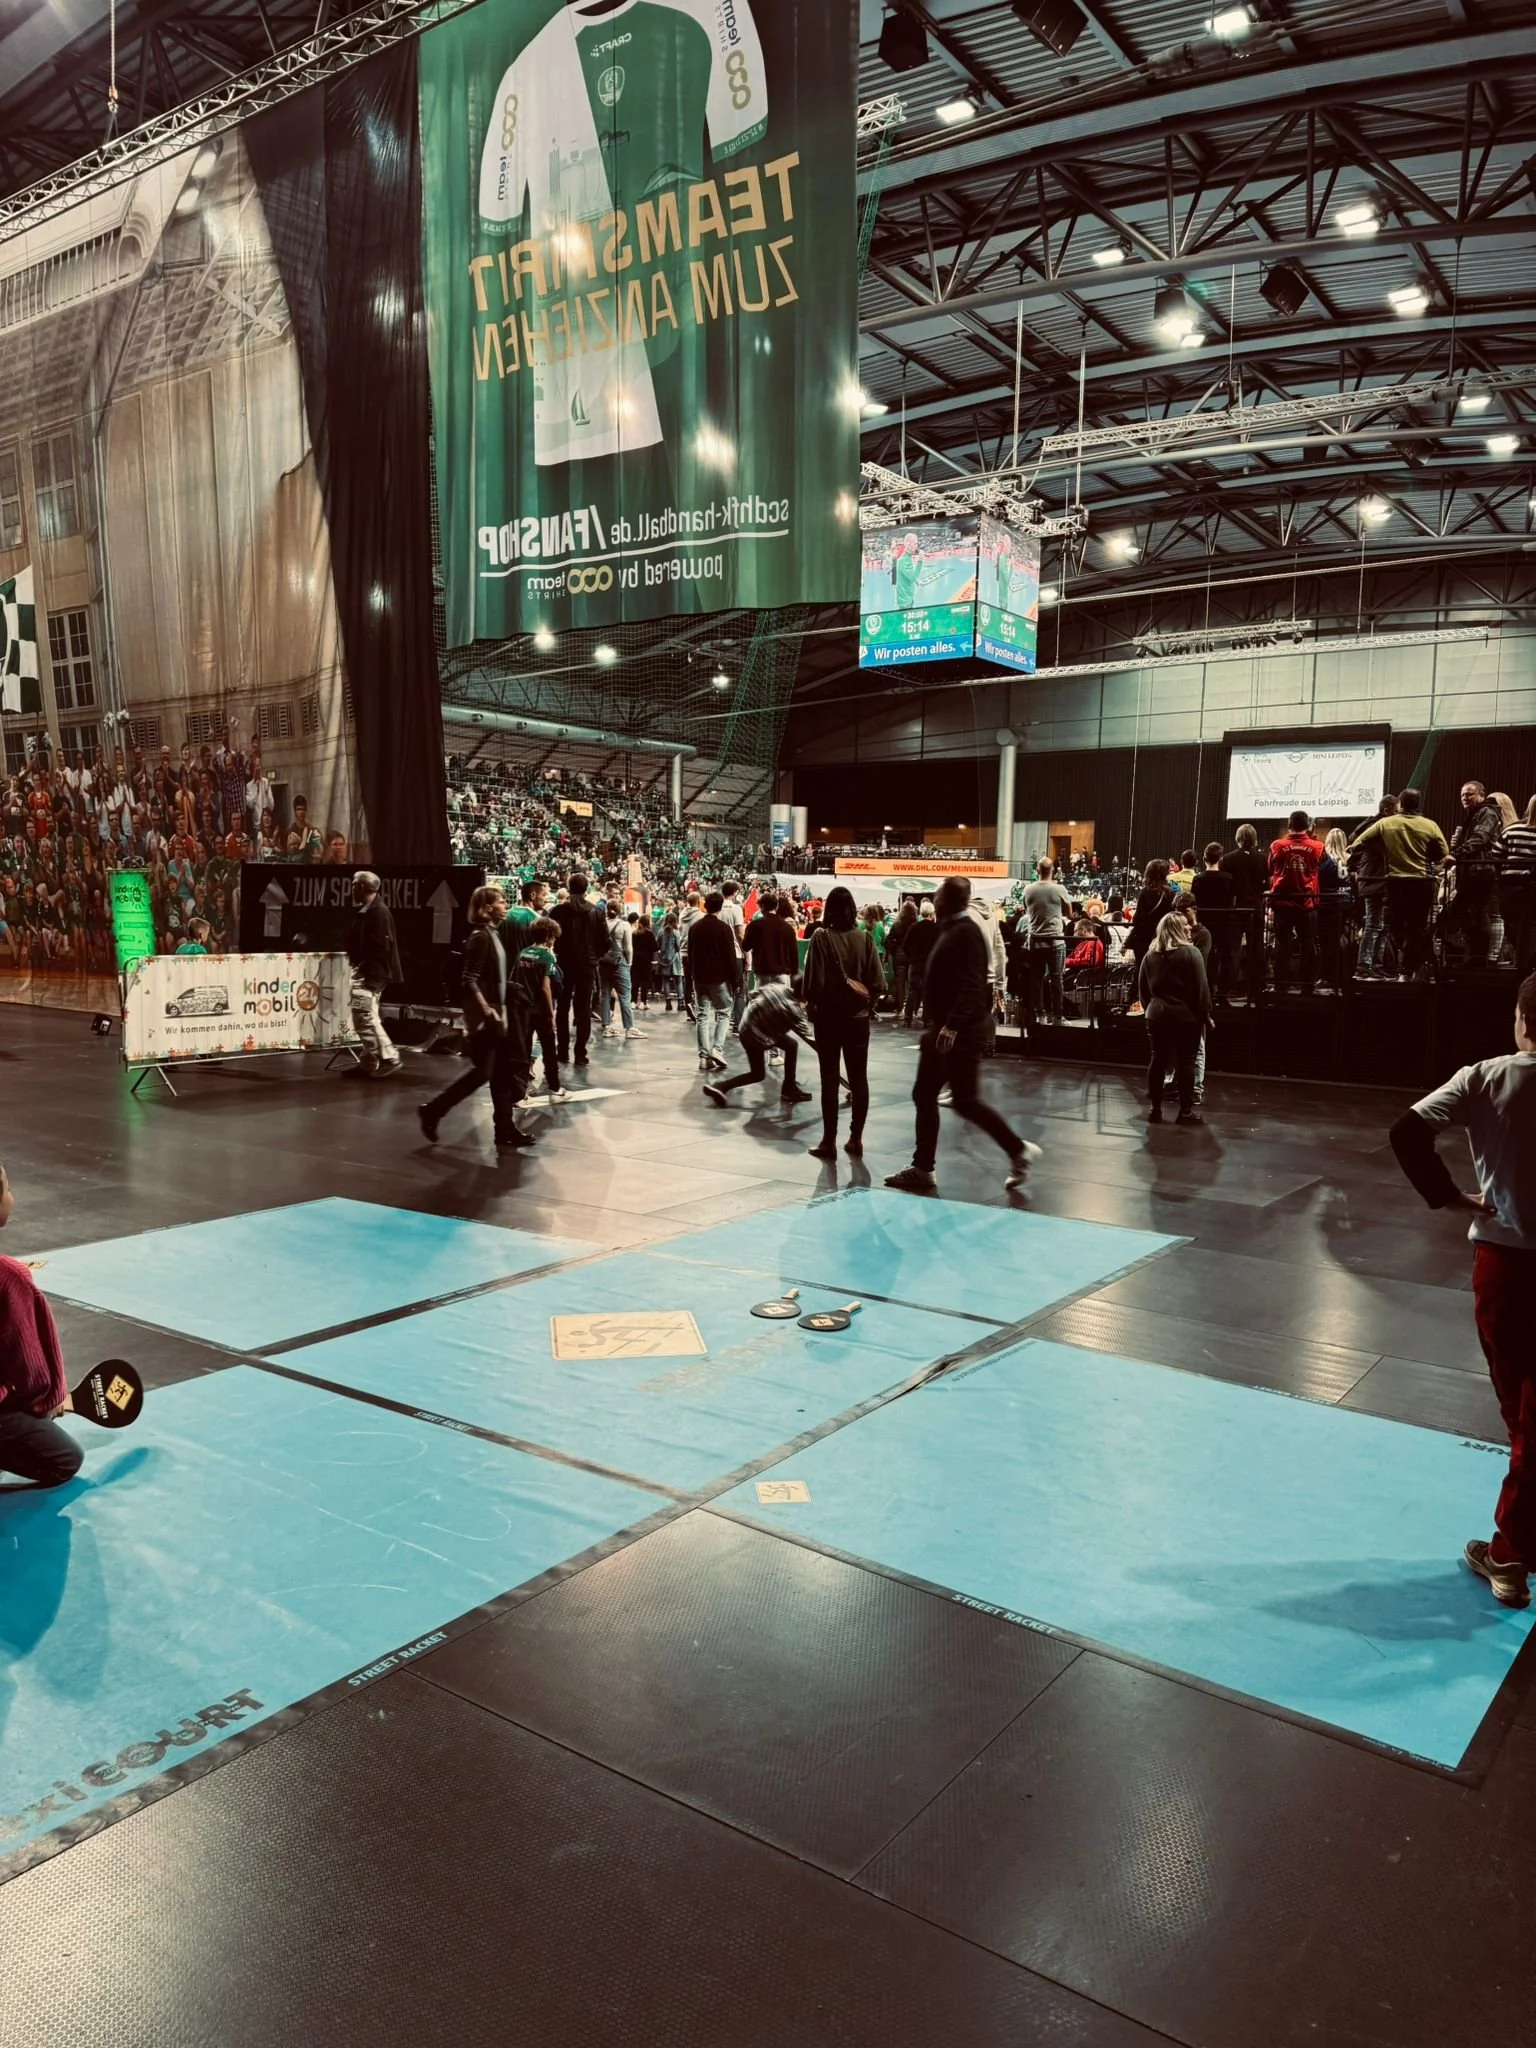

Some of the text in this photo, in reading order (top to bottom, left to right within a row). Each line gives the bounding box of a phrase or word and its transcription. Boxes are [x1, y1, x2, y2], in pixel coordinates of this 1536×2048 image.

[902, 619, 930, 634] 15:14
[874, 641, 956, 661] Wir posten alles.
[1254, 798, 1299, 807] Fahrfreude
[893, 863, 994, 873] WWW.DHL.COM/MEINVEREIN
[293, 877, 422, 909] ZUM SPAKEL
[243, 977, 297, 995] kinder
[243, 995, 296, 1016] mobil
[165, 1026, 178, 1034] Wir
[180, 1025, 216, 1034] kommen
[218, 1022, 243, 1032] dahin,
[258, 1021, 268, 1029] du
[270, 1019, 287, 1028] bist!
[952, 1594, 1056, 1634] STREET RACKET
[347, 1631, 448, 1687] STREET RACKET
